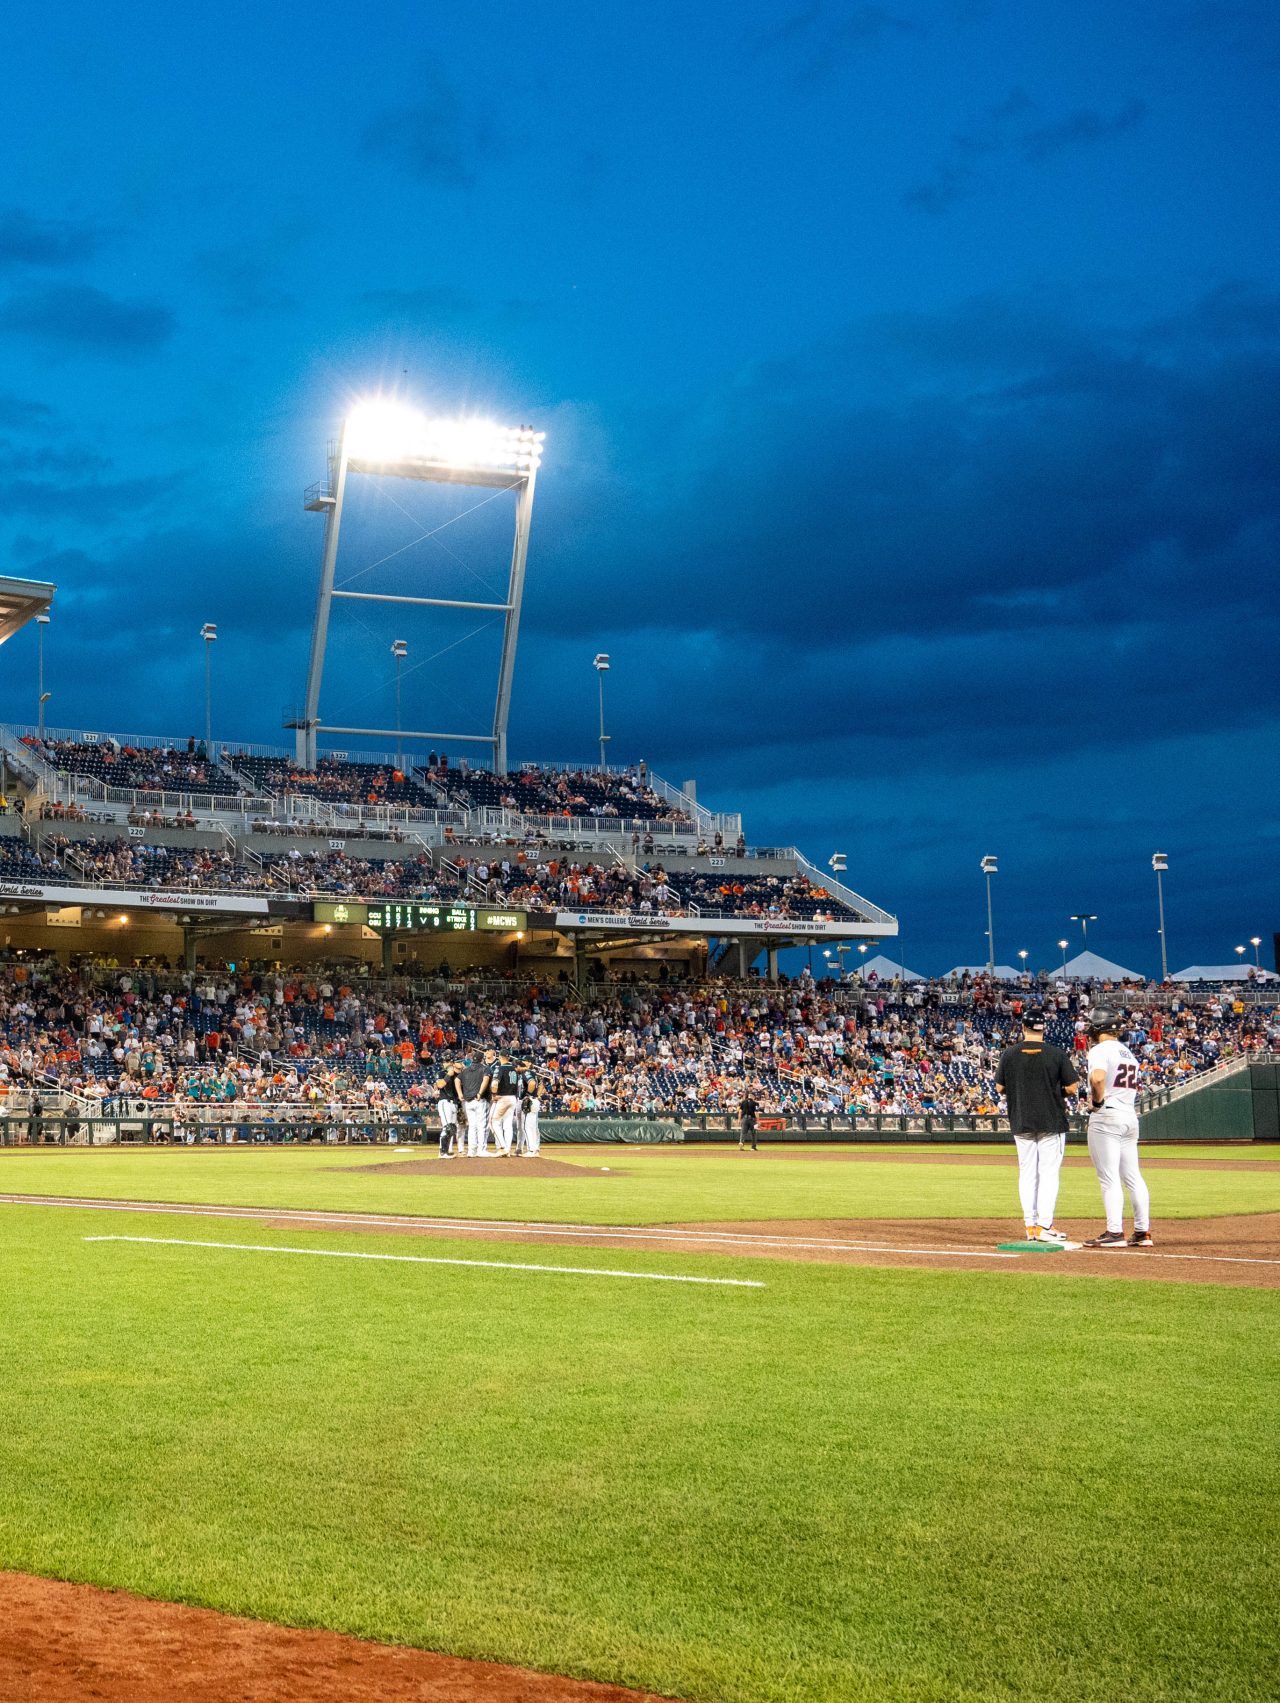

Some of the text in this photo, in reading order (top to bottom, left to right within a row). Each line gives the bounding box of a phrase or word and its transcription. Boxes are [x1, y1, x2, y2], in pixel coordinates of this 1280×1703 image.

[180, 897, 196, 905] SHOW
[196, 898, 205, 906] ON
[205, 899, 218, 907] DIRT
[487, 916, 518, 927] #MCWS
[587, 916, 604, 924] MEN'S
[604, 917, 627, 925] COLLEGE
[453, 922, 466, 930] OUT
[1113, 1063, 1136, 1090] 22
